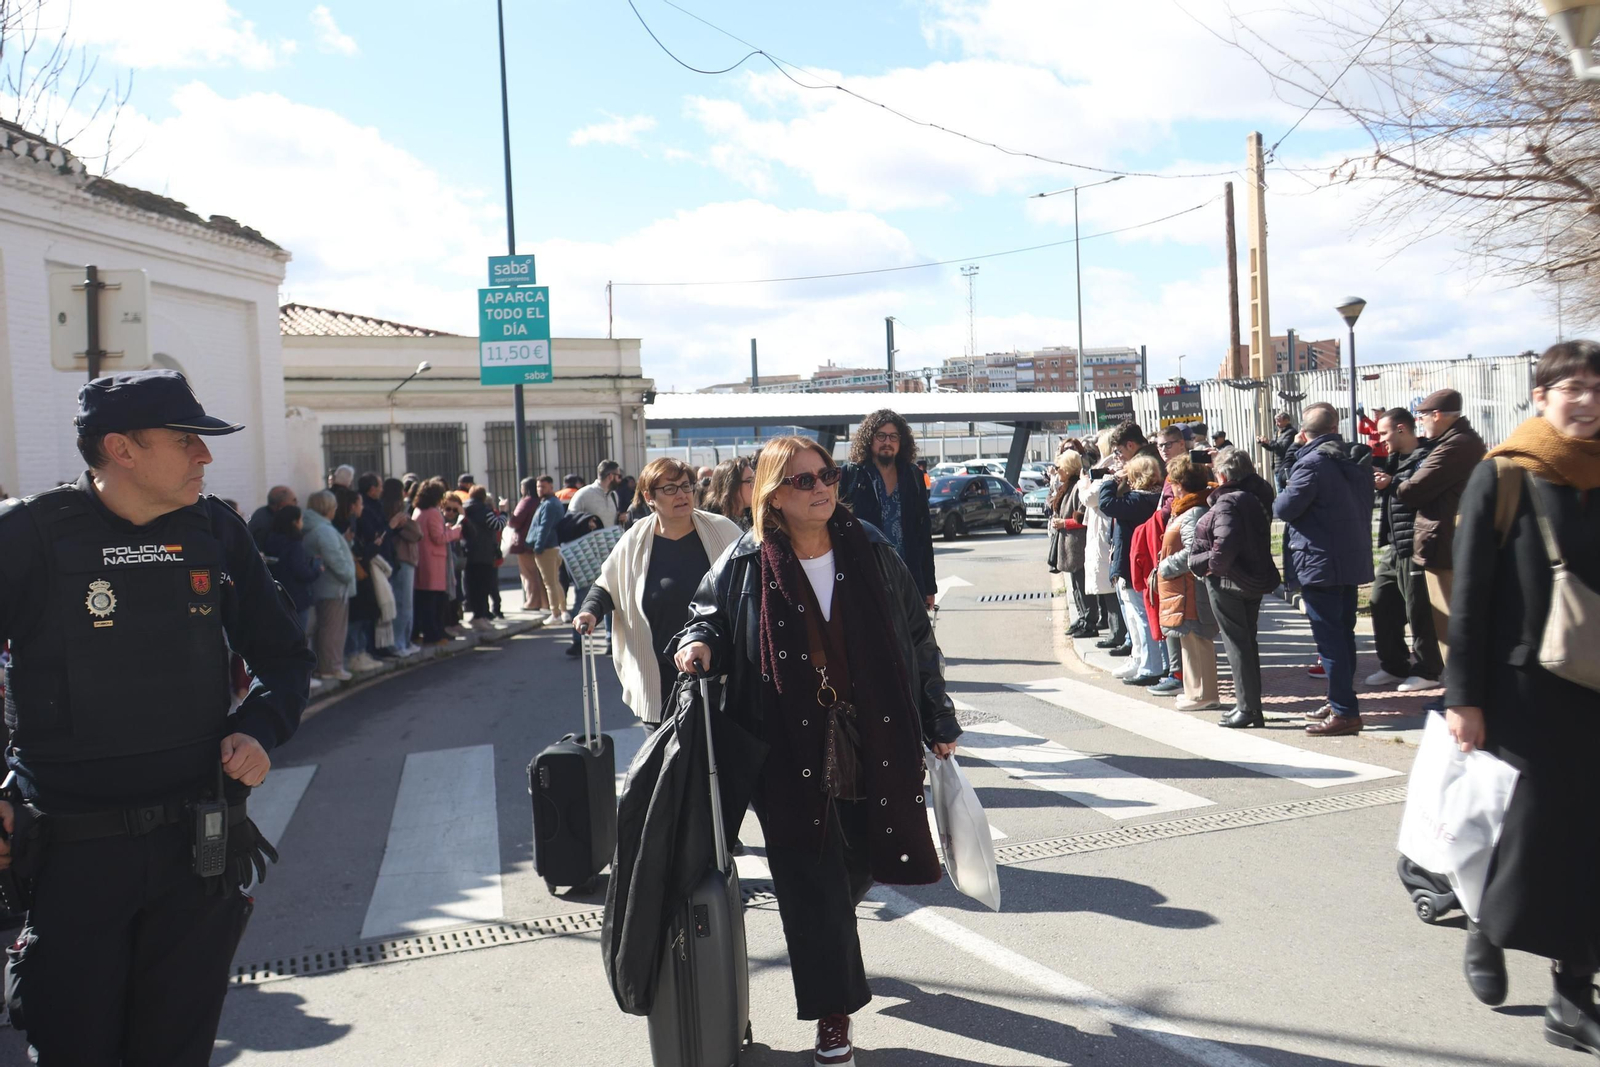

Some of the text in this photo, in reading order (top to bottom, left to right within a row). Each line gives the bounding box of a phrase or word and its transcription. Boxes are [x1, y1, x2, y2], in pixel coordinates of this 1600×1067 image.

[494, 259, 530, 276] saba
[485, 291, 545, 304] APARCA
[485, 307, 545, 320] TODO EL
[503, 321, 528, 336] DÍA
[524, 371, 547, 380] saba
[1099, 412, 1132, 420] enterprise
[102, 544, 168, 556] POLICIA
[103, 553, 184, 566] NACIONAL
